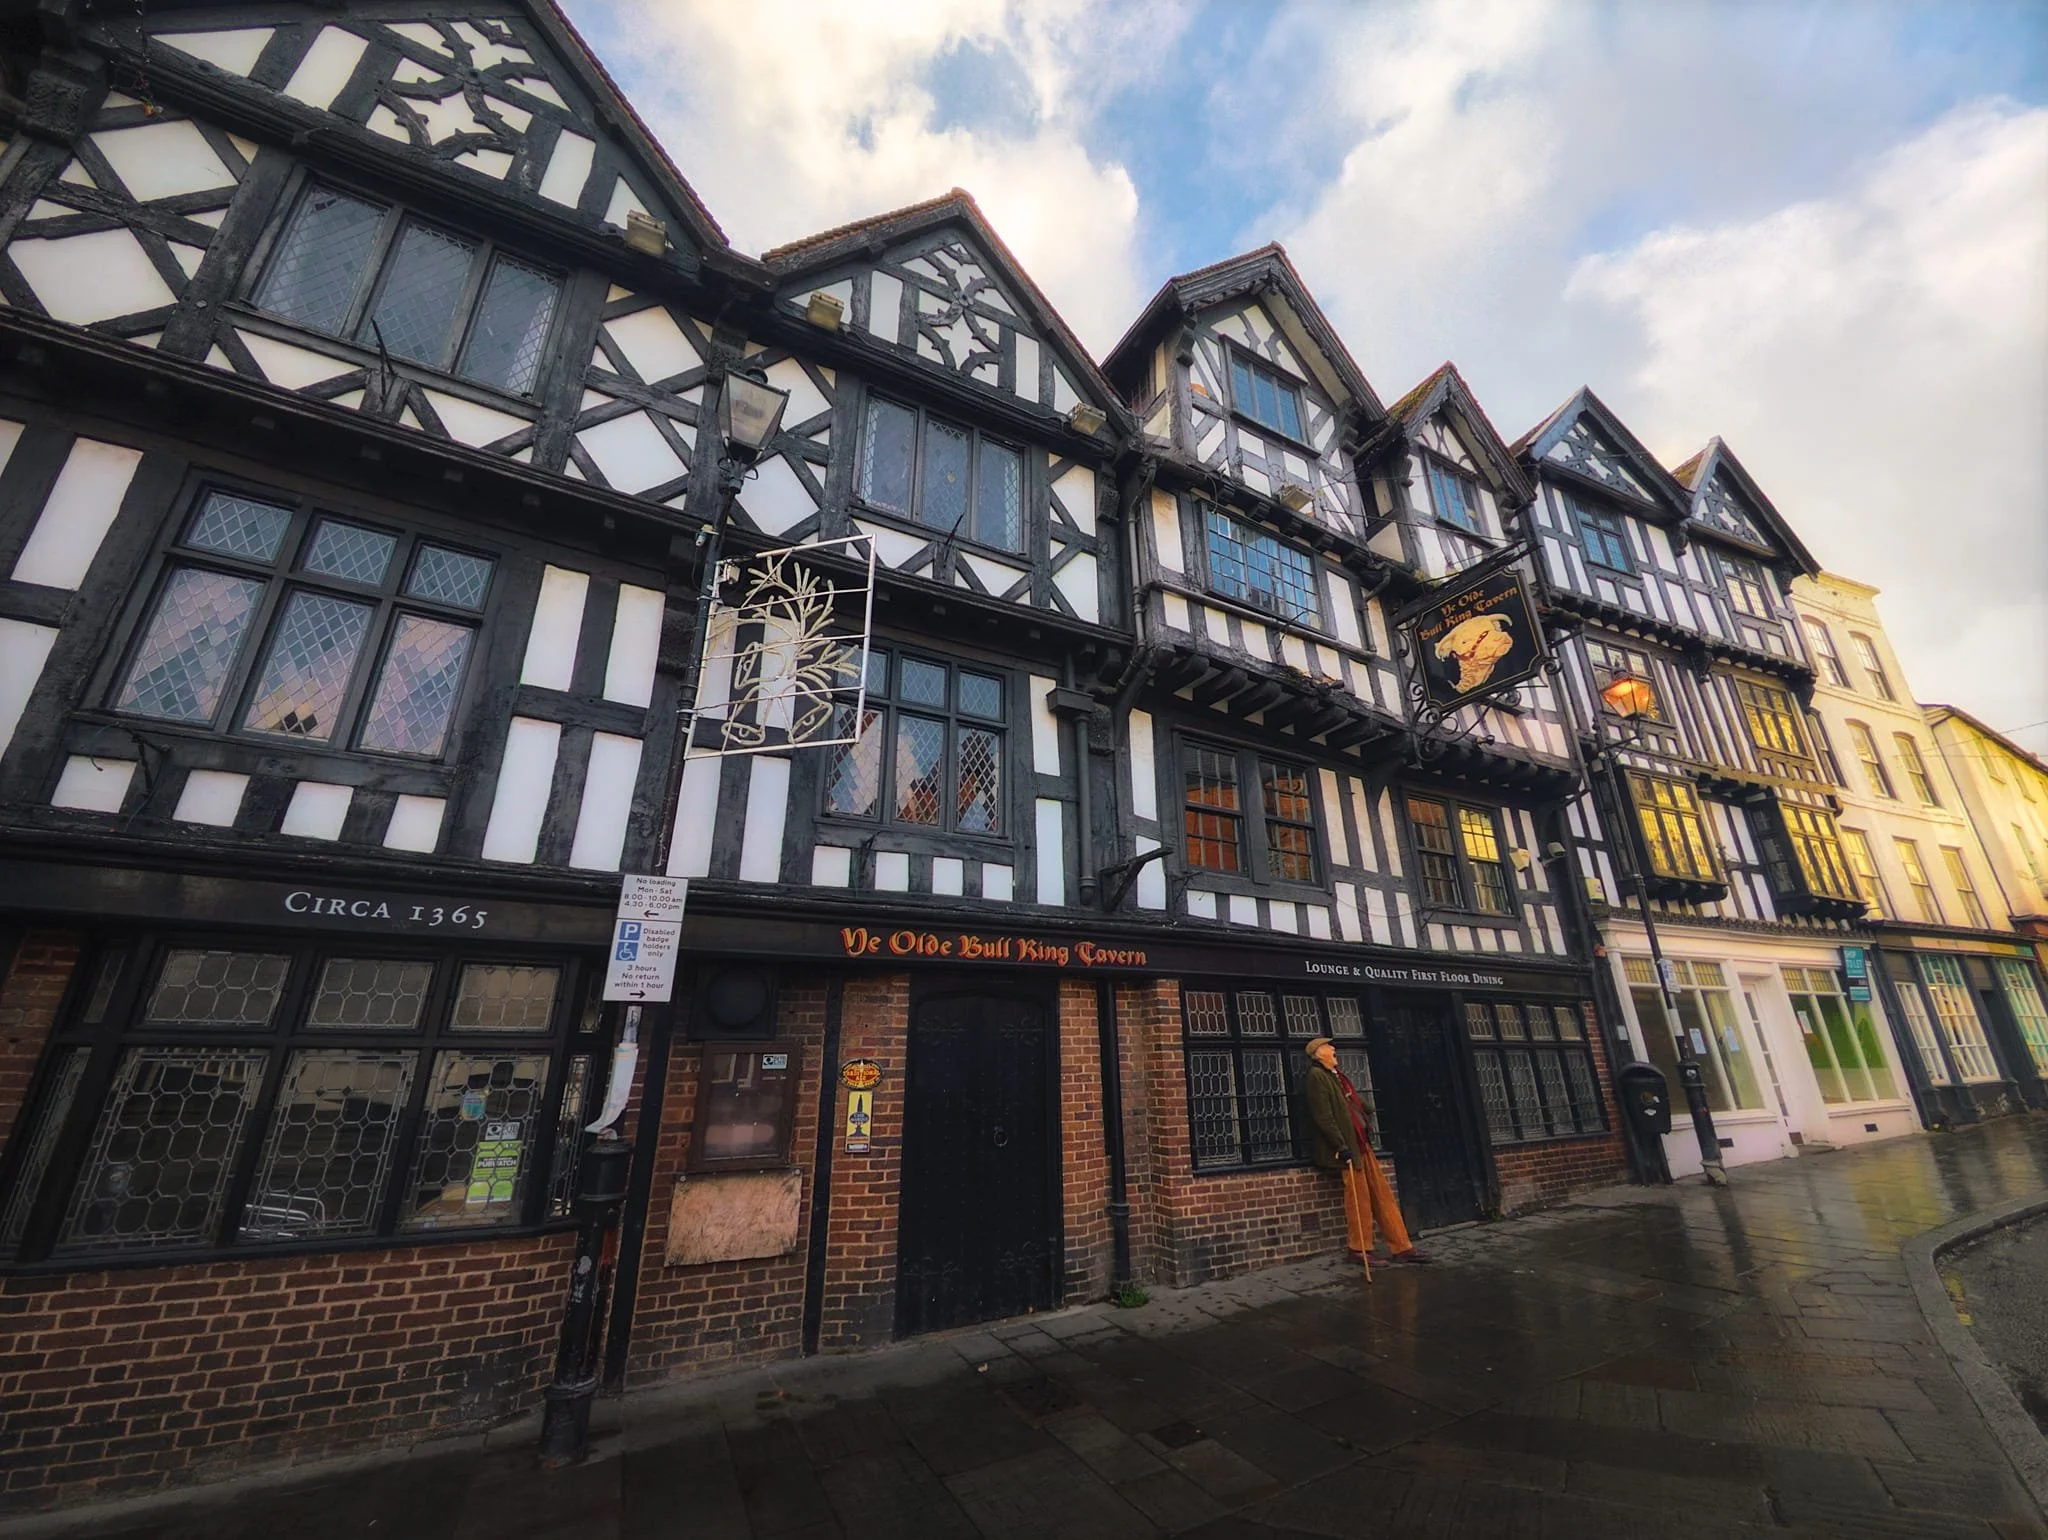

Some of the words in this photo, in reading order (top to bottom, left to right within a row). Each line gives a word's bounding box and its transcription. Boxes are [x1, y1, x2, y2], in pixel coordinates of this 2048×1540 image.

[1458, 589, 1485, 606] Olde
[1420, 622, 1442, 640] Bull
[1444, 610, 1472, 627] Ring
[1473, 587, 1518, 611] Tavern
[649, 878, 676, 887] loading
[285, 891, 391, 919] CIRCA
[409, 905, 488, 929] 1365
[643, 928, 676, 936] Disabled
[648, 950, 664, 958] only
[840, 927, 882, 957] Ye
[888, 930, 952, 956] Olde
[958, 934, 1010, 960] Bull
[1016, 937, 1069, 967] Ring
[1074, 940, 1147, 967] Tavern
[635, 973, 660, 981] return
[1305, 960, 1350, 976] LOUNGE
[1353, 967, 1361, 976] &
[1365, 965, 1408, 980] QUALITY
[1411, 969, 1438, 982] FIRST
[1440, 971, 1470, 984] FLOOR
[1473, 973, 1504, 985] DINING
